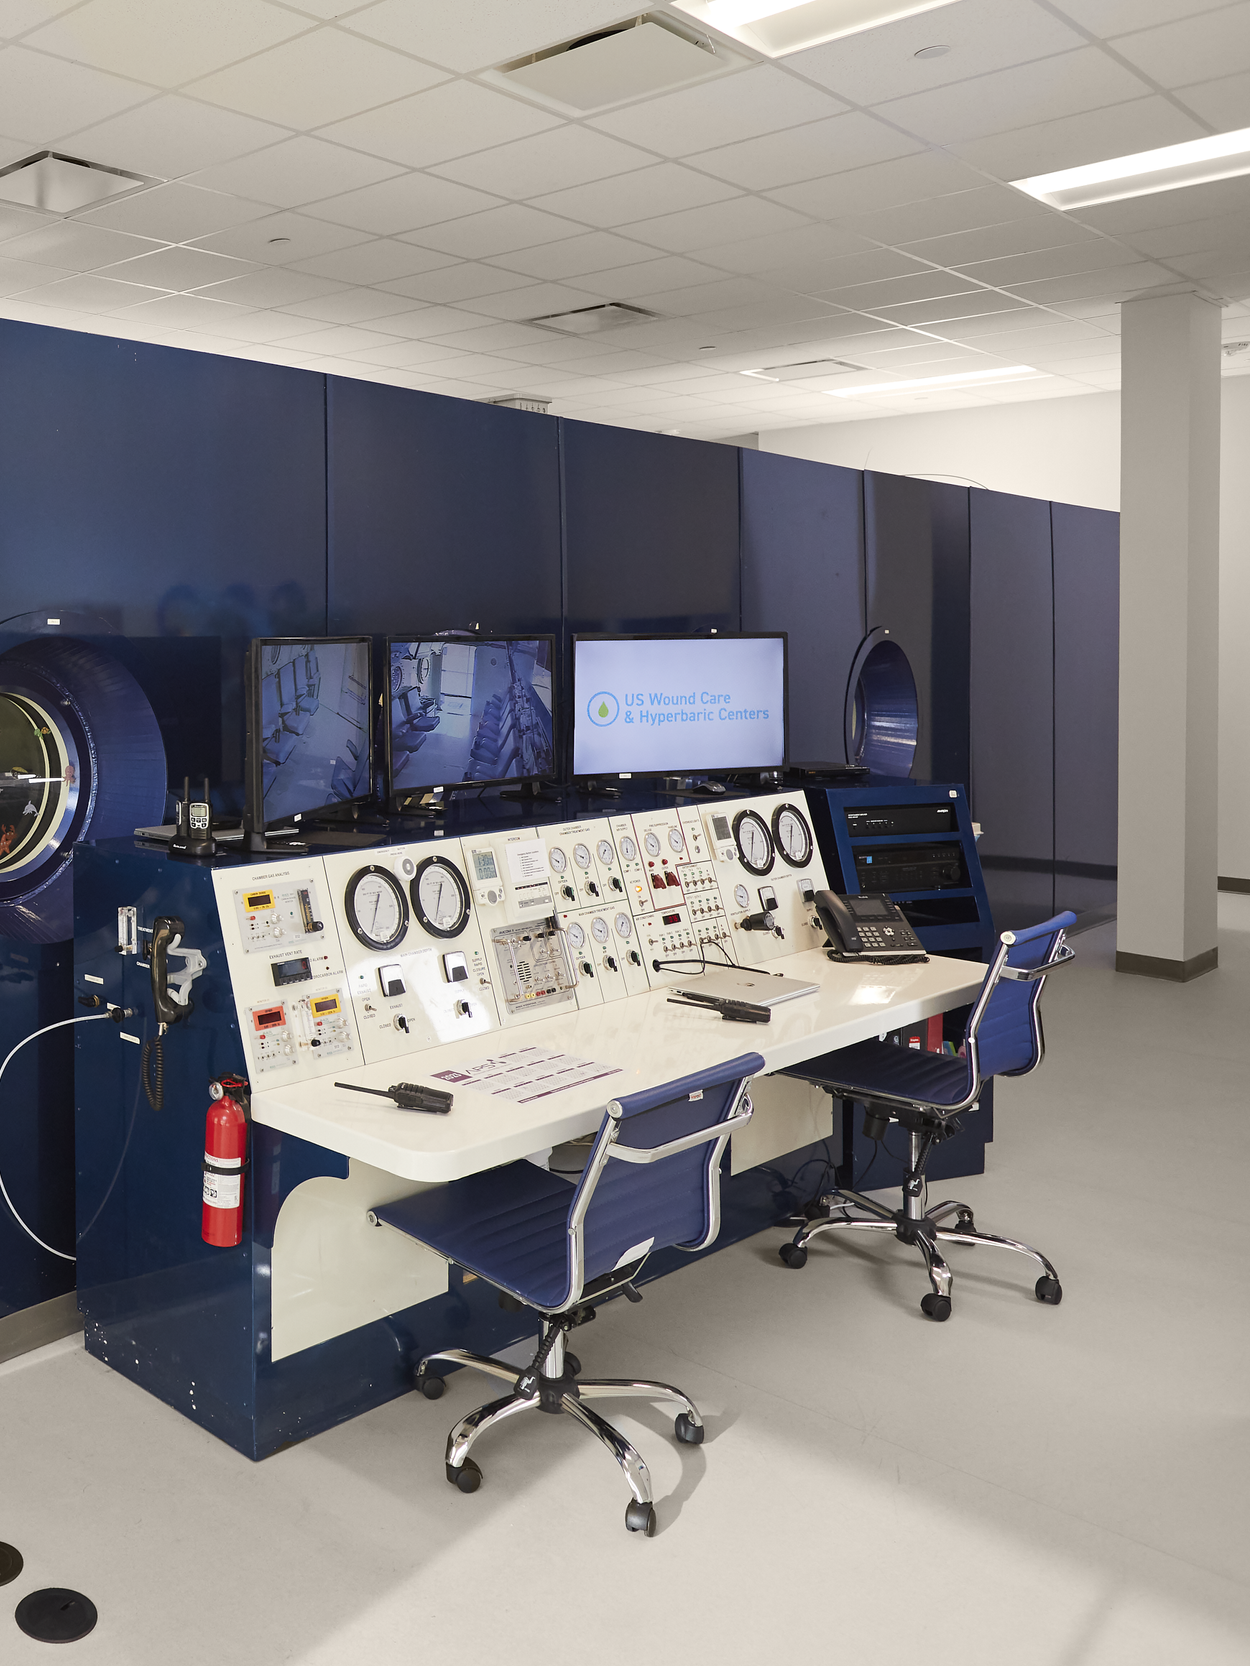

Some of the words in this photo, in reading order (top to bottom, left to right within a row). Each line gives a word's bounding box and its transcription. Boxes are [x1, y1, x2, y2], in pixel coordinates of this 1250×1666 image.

[624, 693, 644, 706] US
[649, 692, 696, 706] Wound
[700, 691, 731, 705] Care
[624, 710, 634, 723] &
[640, 709, 714, 726] Hyperbaric
[718, 707, 769, 721] Centers
